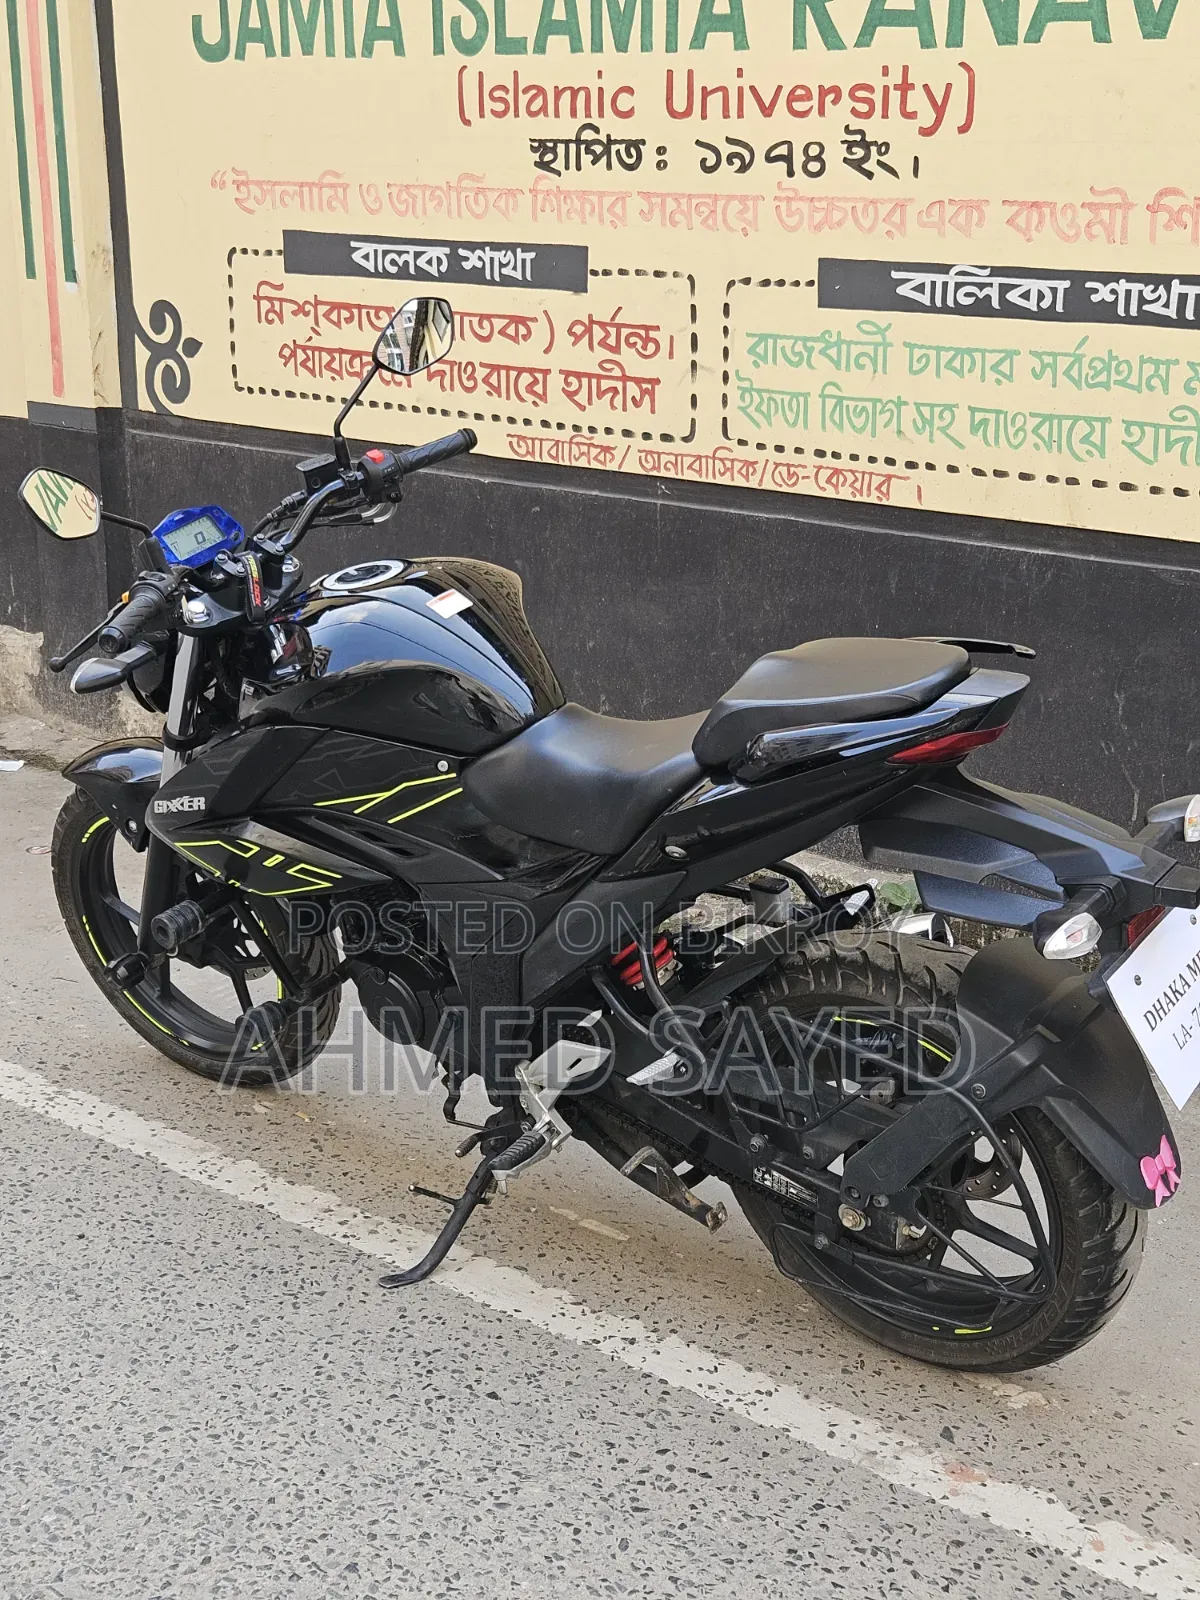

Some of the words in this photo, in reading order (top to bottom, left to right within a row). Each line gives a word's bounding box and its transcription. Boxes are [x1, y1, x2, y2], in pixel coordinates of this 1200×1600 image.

[457, 64, 635, 127] (Islamic
[665, 61, 976, 137] University)
[695, 136, 827, 179] ১৯৭৪
[358, 182, 384, 217] ও
[386, 172, 524, 221] জাগতিক
[529, 173, 633, 230] শিক্ষার
[773, 181, 916, 241] উচ্চতর
[916, 199, 990, 239] এক
[1001, 186, 1138, 245] কওমী
[350, 240, 451, 278] বালক
[458, 246, 537, 283] শাখা
[890, 264, 1071, 313] বালিকা
[1085, 278, 1200, 320] শাখা
[558, 358, 662, 415] হাদীস
[745, 319, 894, 375] রাজধানী
[903, 341, 1022, 386] ঢাকার
[1029, 335, 1180, 396] সর্বপ্রথম
[734, 368, 811, 431] ইফতা
[818, 381, 910, 439] বিভাগ
[912, 401, 967, 451] সহ
[153, 795, 206, 815] GIXXER
[1143, 973, 1192, 1033] DHAKA
